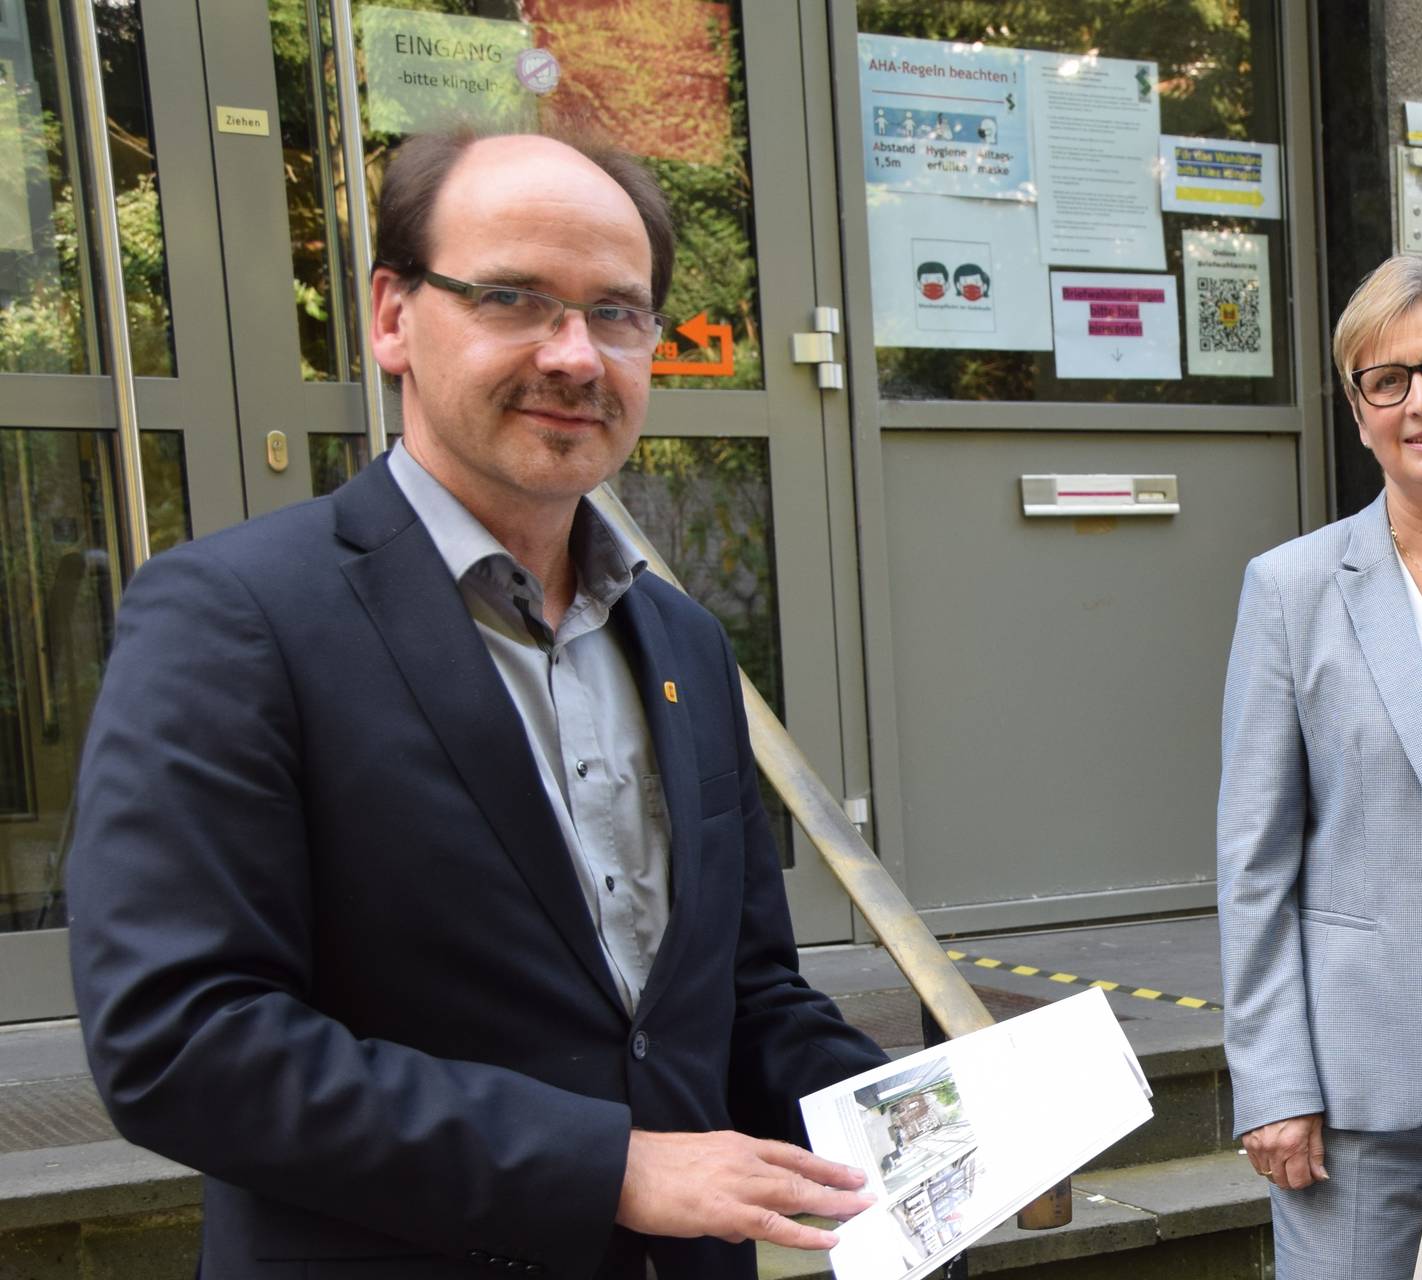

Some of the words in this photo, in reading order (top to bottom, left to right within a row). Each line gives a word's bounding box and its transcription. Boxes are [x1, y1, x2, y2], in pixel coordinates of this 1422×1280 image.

[395, 34, 503, 64] EINGANG
[869, 59, 945, 78] AHA-Regeln
[950, 66, 1008, 83] beachten
[226, 115, 261, 127] Ziehen
[873, 142, 915, 154] Abstand
[926, 145, 967, 159] Hygiene
[875, 157, 901, 169] 1,5m
